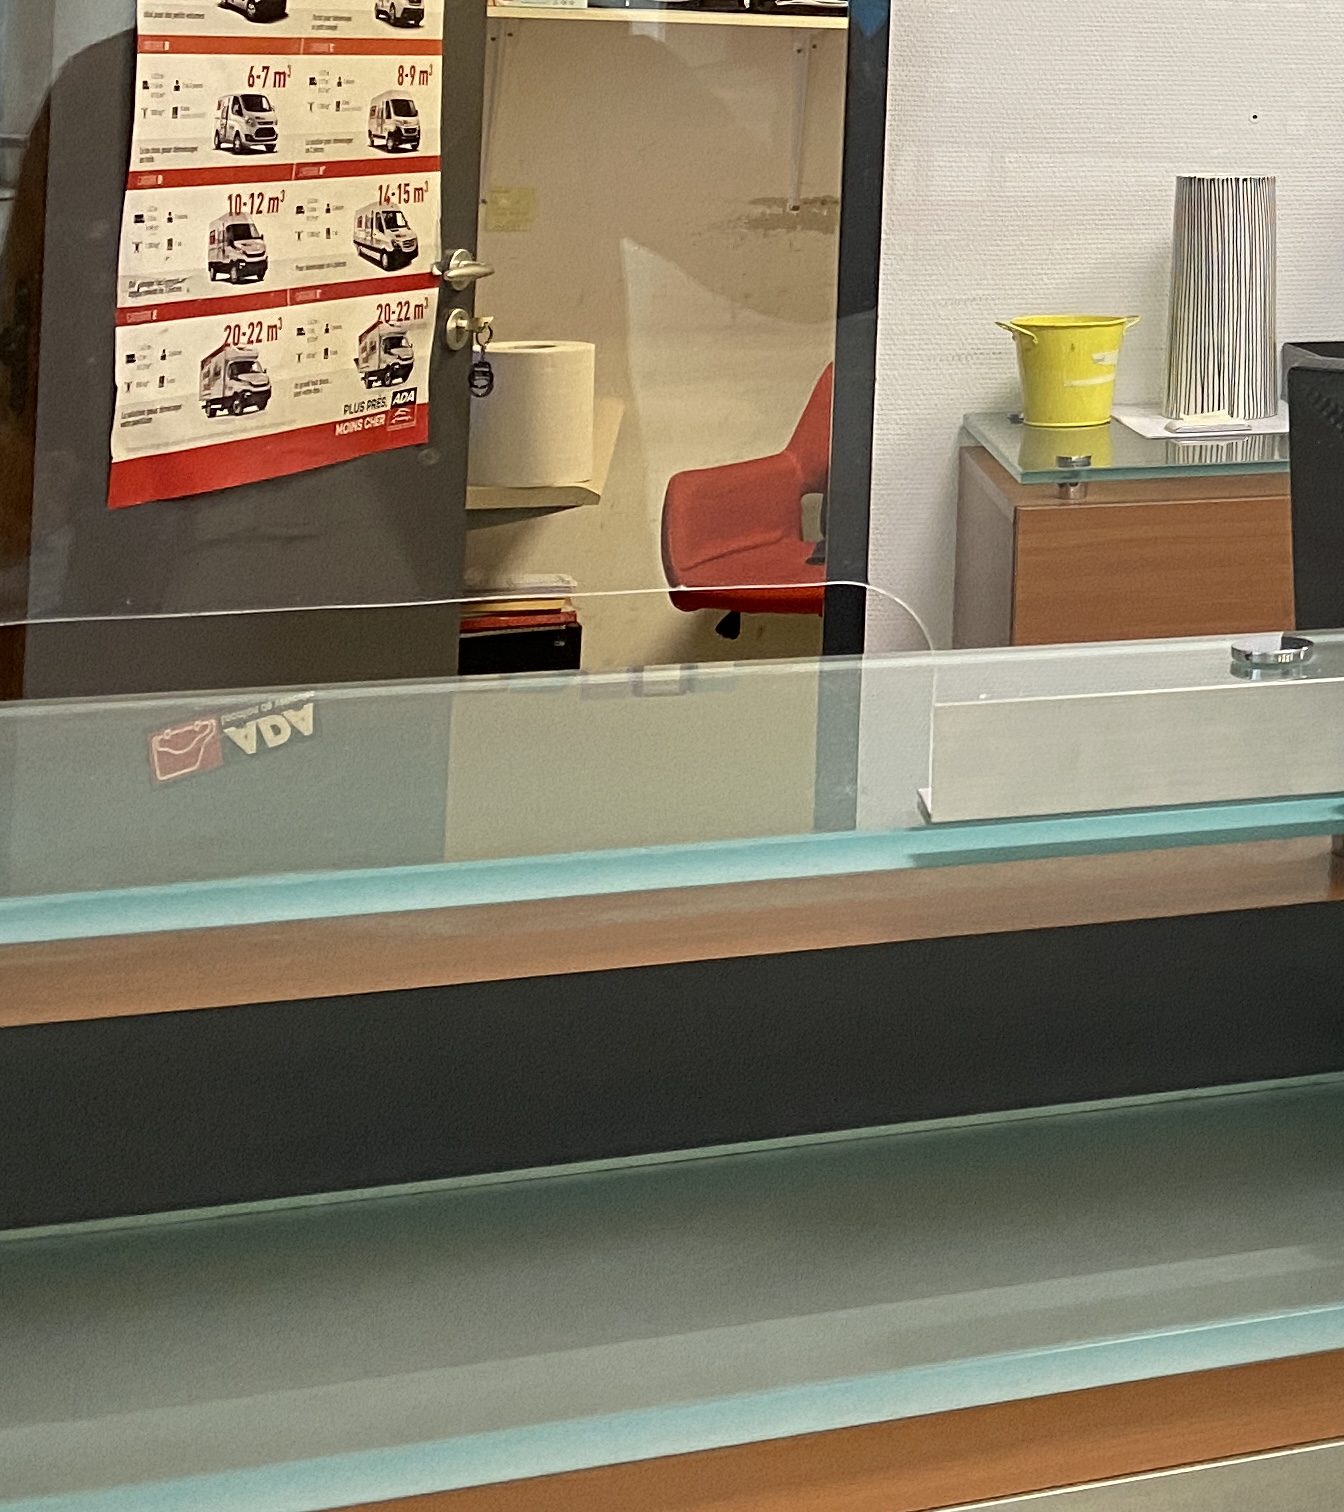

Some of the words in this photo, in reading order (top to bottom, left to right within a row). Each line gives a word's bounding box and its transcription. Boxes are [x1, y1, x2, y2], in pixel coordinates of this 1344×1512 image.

[343, 400, 366, 415] PLUS
[392, 390, 415, 406] ADA
[335, 418, 363, 436] MOINS
[364, 414, 386, 430] CHER
